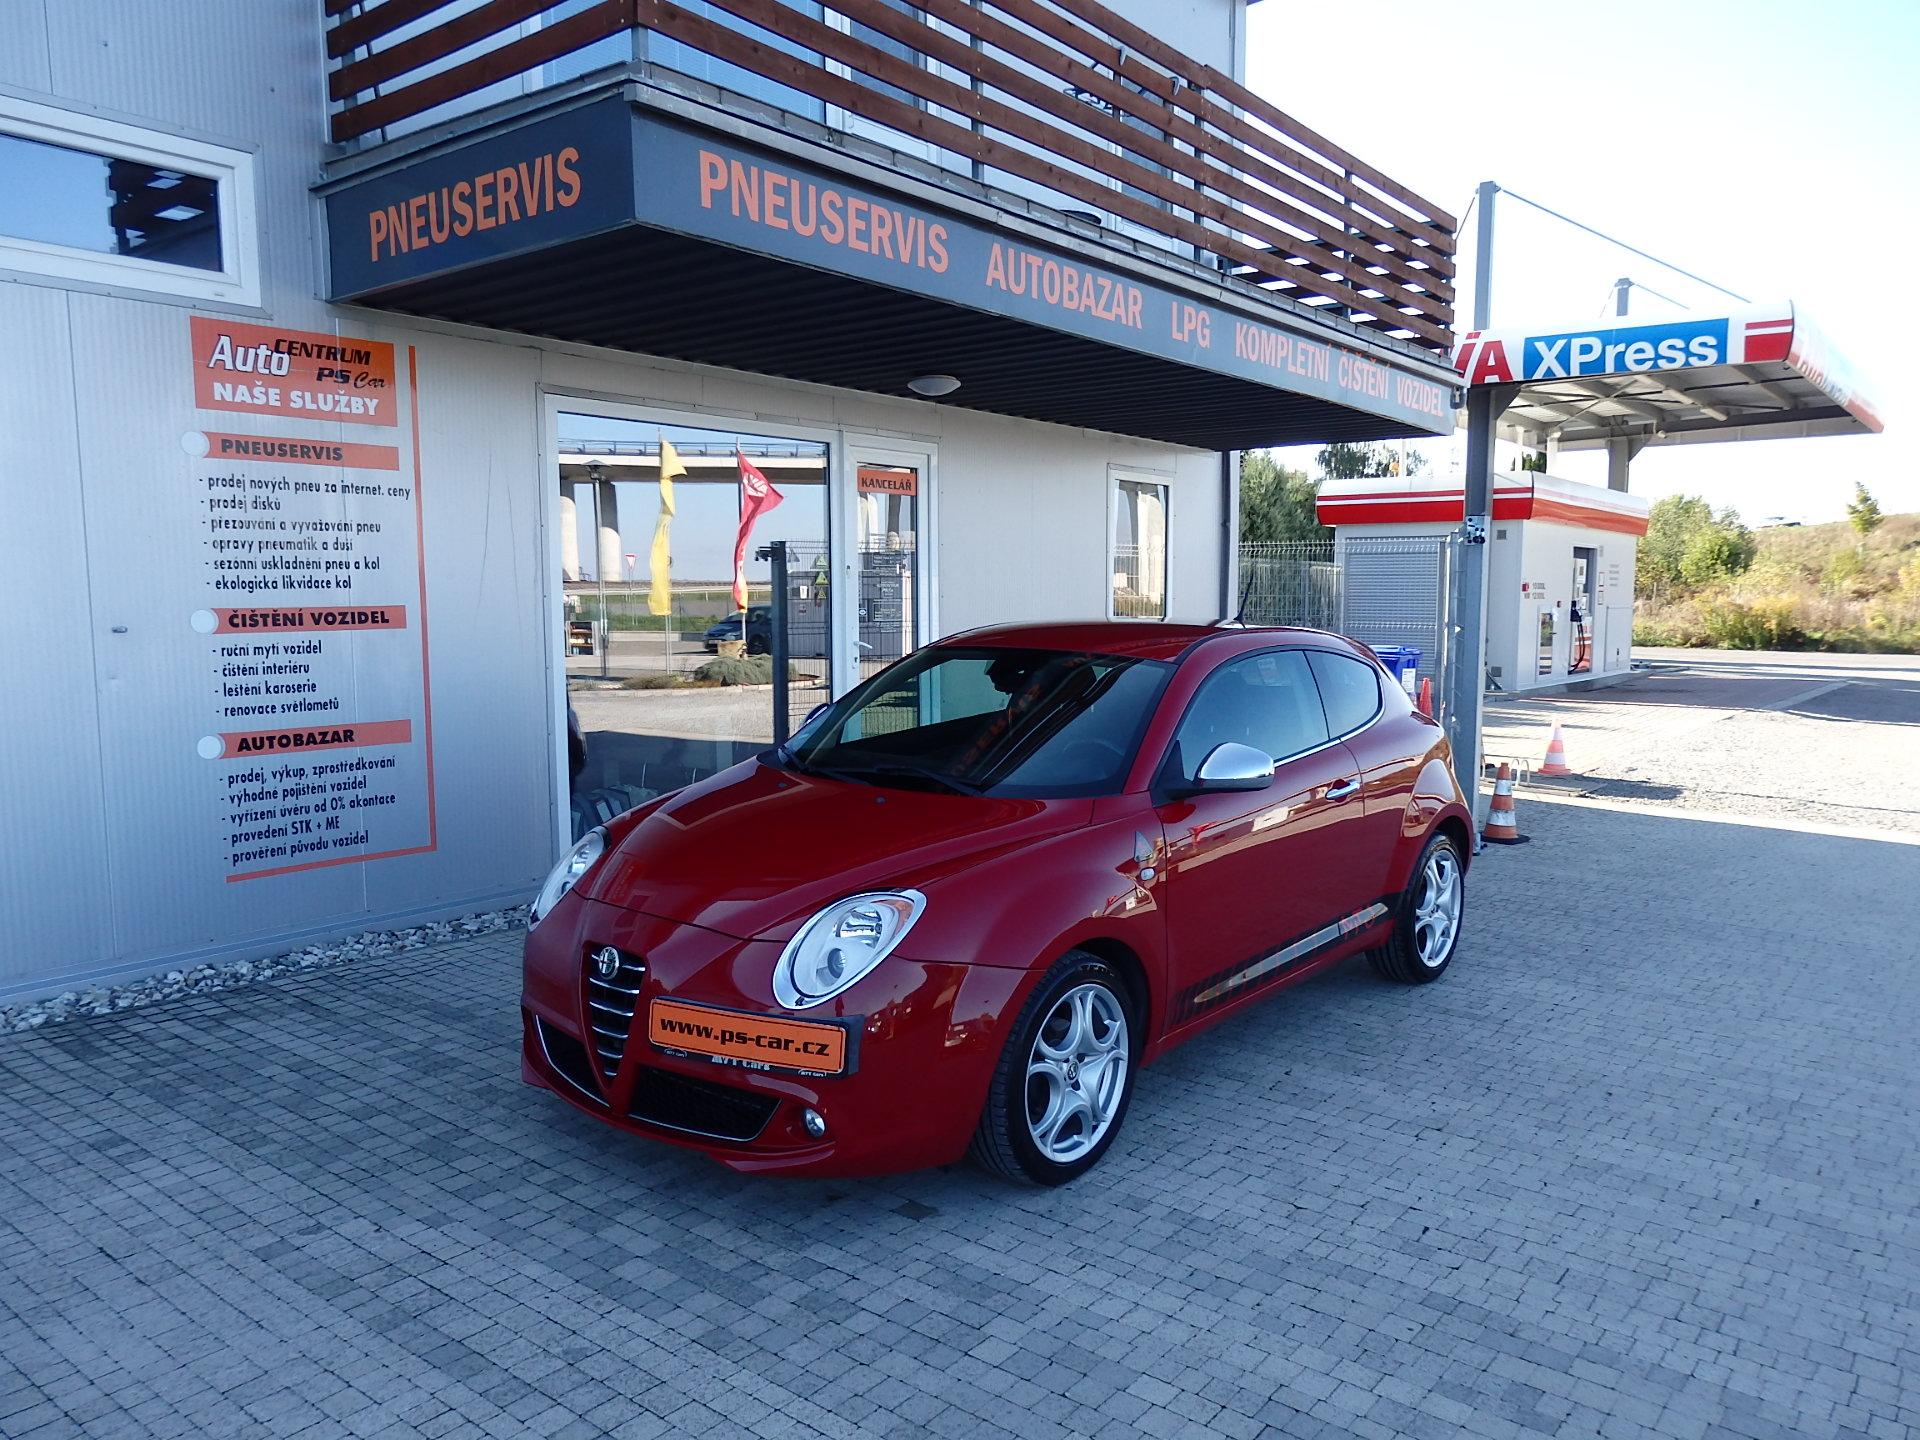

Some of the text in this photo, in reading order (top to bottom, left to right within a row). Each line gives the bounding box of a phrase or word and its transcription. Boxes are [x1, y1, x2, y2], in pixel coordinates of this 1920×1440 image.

[369, 147, 581, 262] PNEUSERVIS
[699, 150, 1444, 417] PNEUSERVIS AUTOBAZAR LPG KOMPLETNÍ ČIŠTĚNÍ VOZIDEL
[207, 334, 371, 377] Auto CENTRUM
[1531, 334, 1718, 380] XPress
[316, 367, 386, 389] PS Car
[213, 380, 379, 416] NAŠE SLUŽBY
[221, 438, 343, 461] PNEUSERVIS
[208, 473, 410, 500] prodej nových pneu za internet. ceny
[861, 477, 912, 491] KANCELÁŘ
[210, 494, 280, 513] prodej disků
[211, 516, 381, 535] přezouvání a vyvažování pneu
[213, 536, 352, 553] opravy pneumatik a duší
[214, 555, 380, 573] sezónní uskladnění pneu a kol
[215, 575, 351, 593] ekologická likvidace kol
[228, 608, 389, 628] ČIŠTĚNÍ VOZIDEL
[221, 639, 322, 659] ruční mytí vozidel
[222, 660, 310, 677] čištění interiéru
[223, 678, 317, 697] leštění karoserie
[224, 697, 339, 717] renovace světlometů
[237, 730, 355, 752] AUTOBAZAR
[228, 755, 395, 788] prodej, výkup, zprostředkování
[229, 775, 366, 807] výhodné pojištění vozidel
[230, 794, 395, 827] vyřízení úvěru od 0% akontace
[232, 824, 287, 847] provedení
[292, 819, 312, 835] STK
[326, 816, 340, 830] ME
[233, 830, 368, 867] prověření původu vozidel
[660, 1018, 830, 1057] www.ps-car.cz
